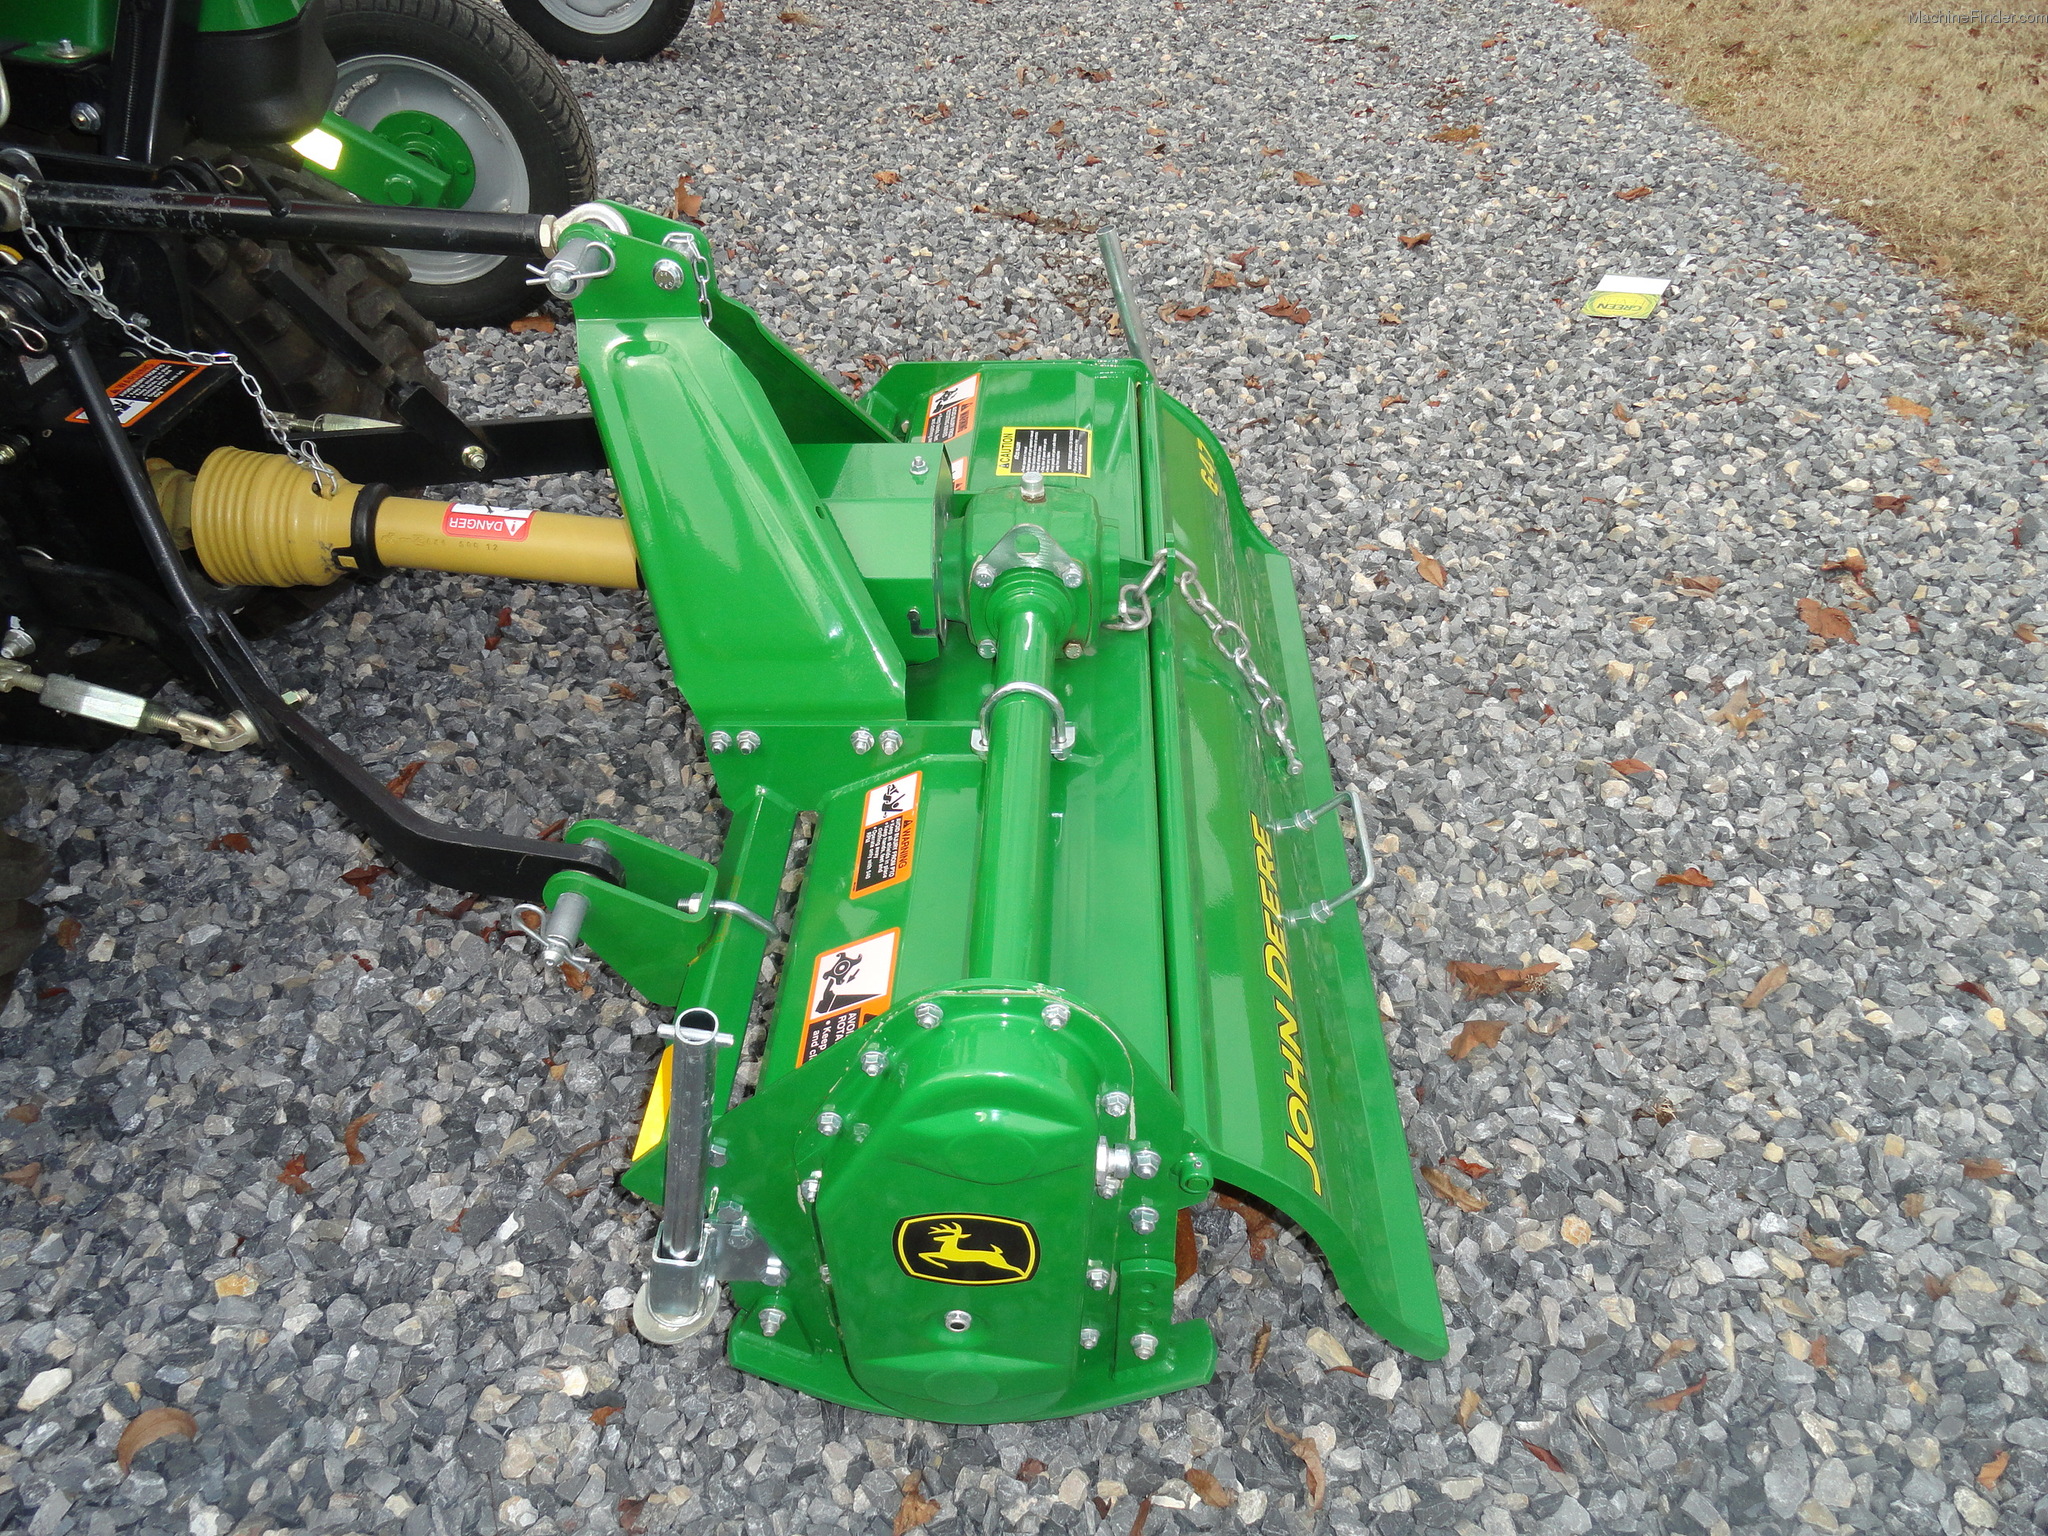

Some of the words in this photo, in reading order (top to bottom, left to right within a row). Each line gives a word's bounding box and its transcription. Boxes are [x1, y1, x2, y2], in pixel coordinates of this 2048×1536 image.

[1597, 303, 1642, 311] GREEN
[1000, 432, 1013, 463] CAUTION
[1196, 437, 1219, 497] 647
[449, 517, 503, 532] DANGER
[899, 828, 911, 868] WARNING
[1250, 810, 1295, 1003] DEERE
[811, 1029, 820, 1048] and
[819, 1026, 832, 1051] Keep
[835, 1015, 846, 1044] ROTA
[845, 1013, 857, 1037] AVOI
[1274, 995, 1322, 1197] JOHN
